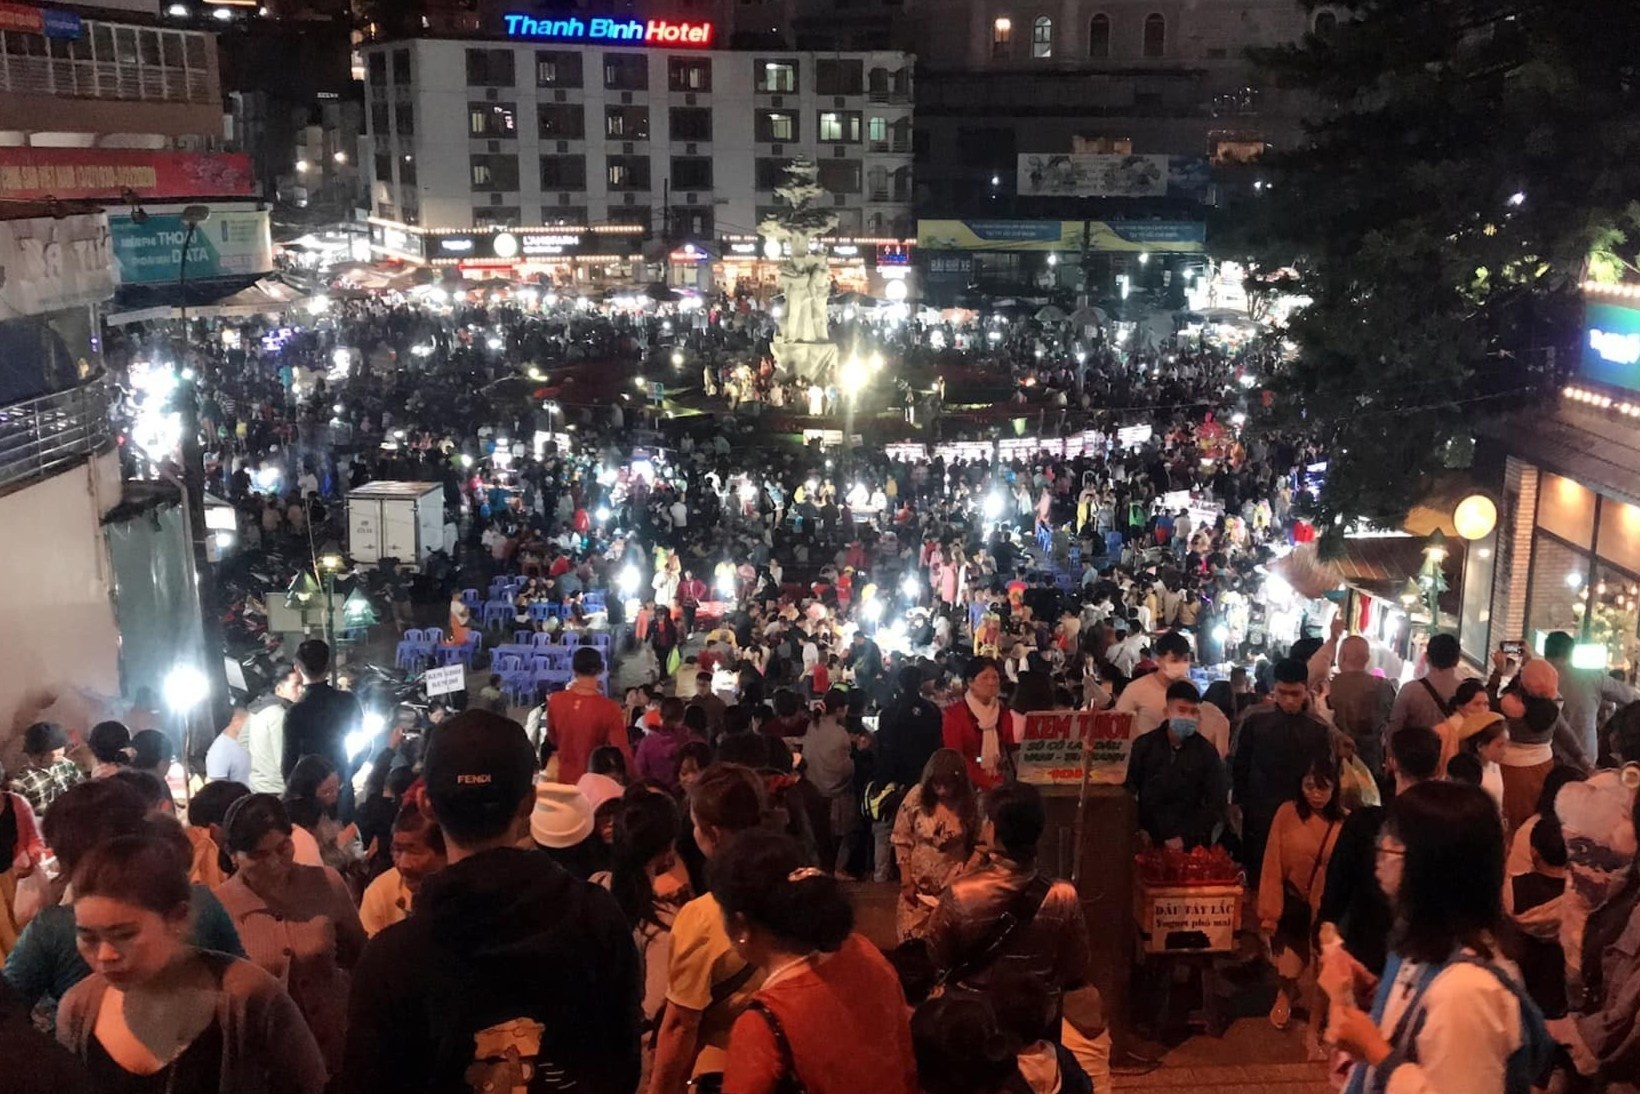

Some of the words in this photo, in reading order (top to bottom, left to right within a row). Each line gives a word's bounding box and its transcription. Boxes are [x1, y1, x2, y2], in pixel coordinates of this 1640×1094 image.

[504, 15, 585, 37] Thanh
[589, 18, 644, 40] Bình
[645, 20, 711, 43] Hotel
[171, 247, 210, 264] DATA
[1024, 715, 1073, 740] KEM
[457, 774, 491, 784] FENDI
